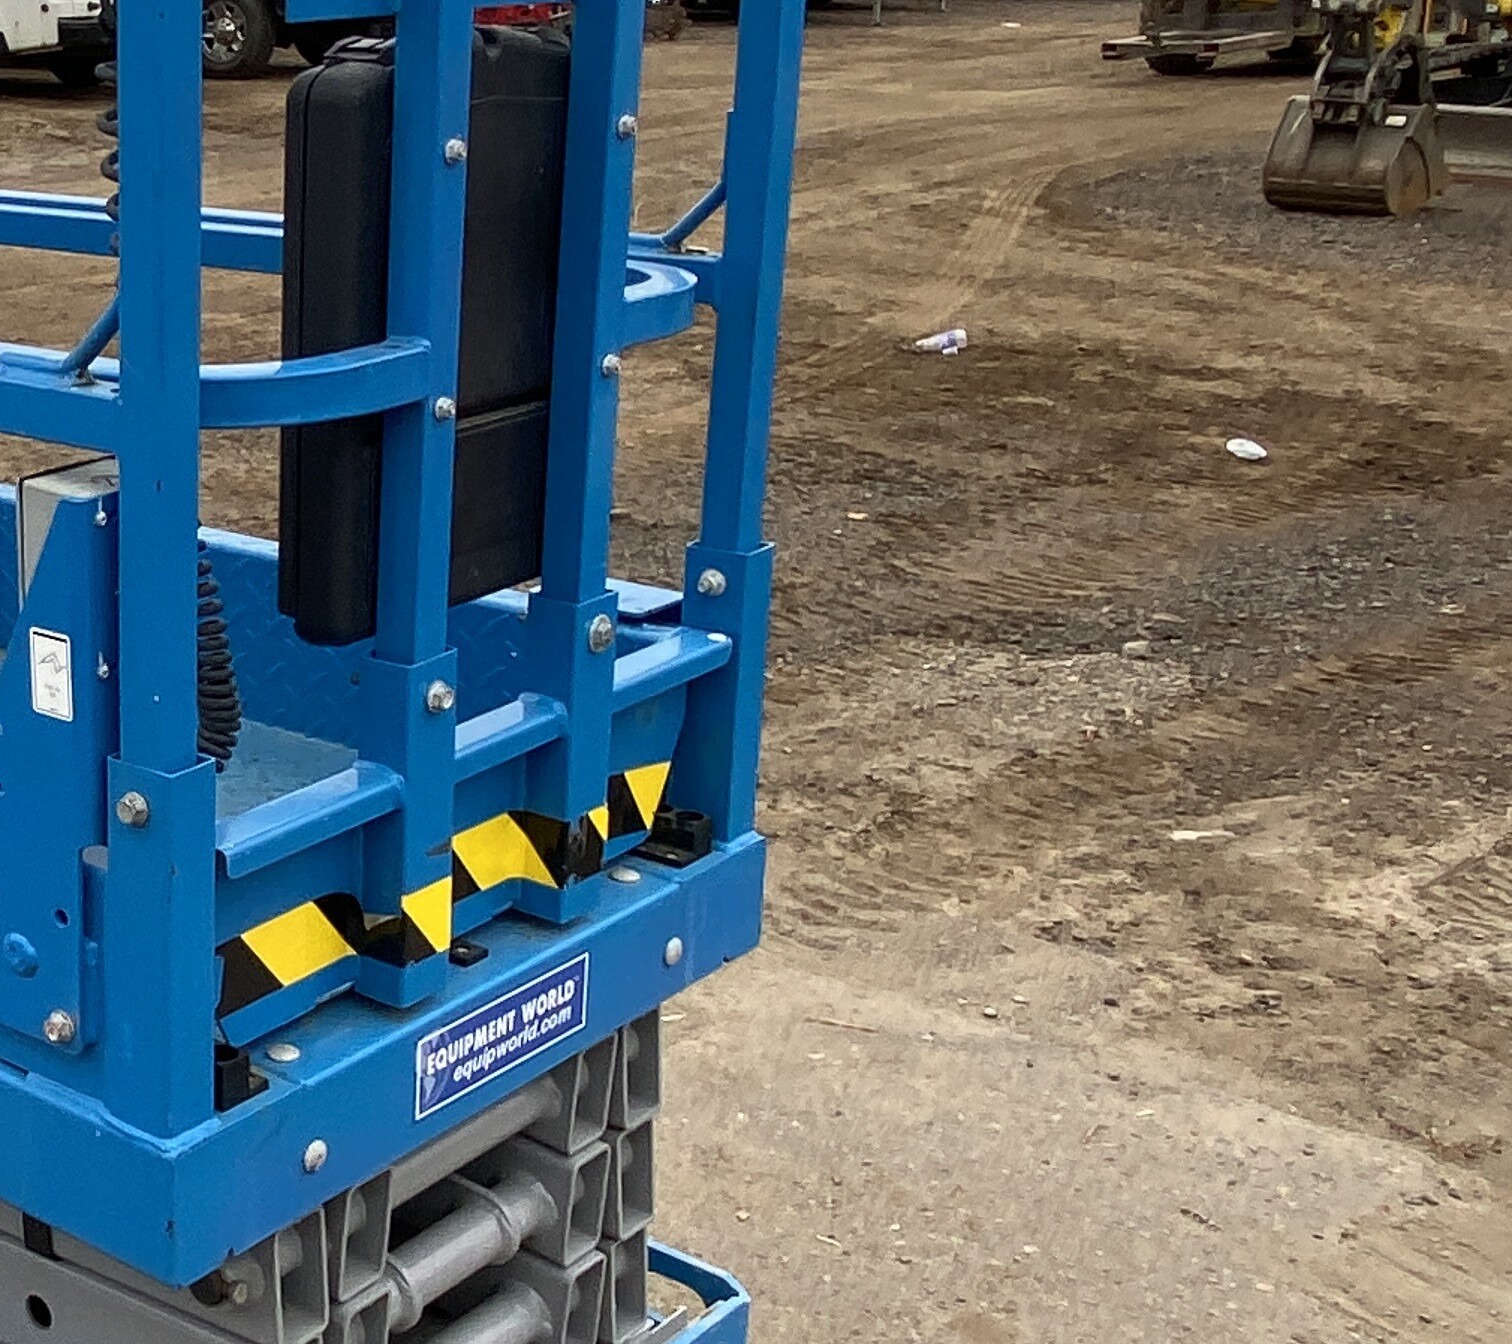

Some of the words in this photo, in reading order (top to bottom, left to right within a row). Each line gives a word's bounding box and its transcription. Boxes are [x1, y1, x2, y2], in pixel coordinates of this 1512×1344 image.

[426, 1008, 516, 1076] EQUIPMENT
[521, 978, 576, 1024] WORLD
[452, 1005, 573, 1082] equipworld.com
